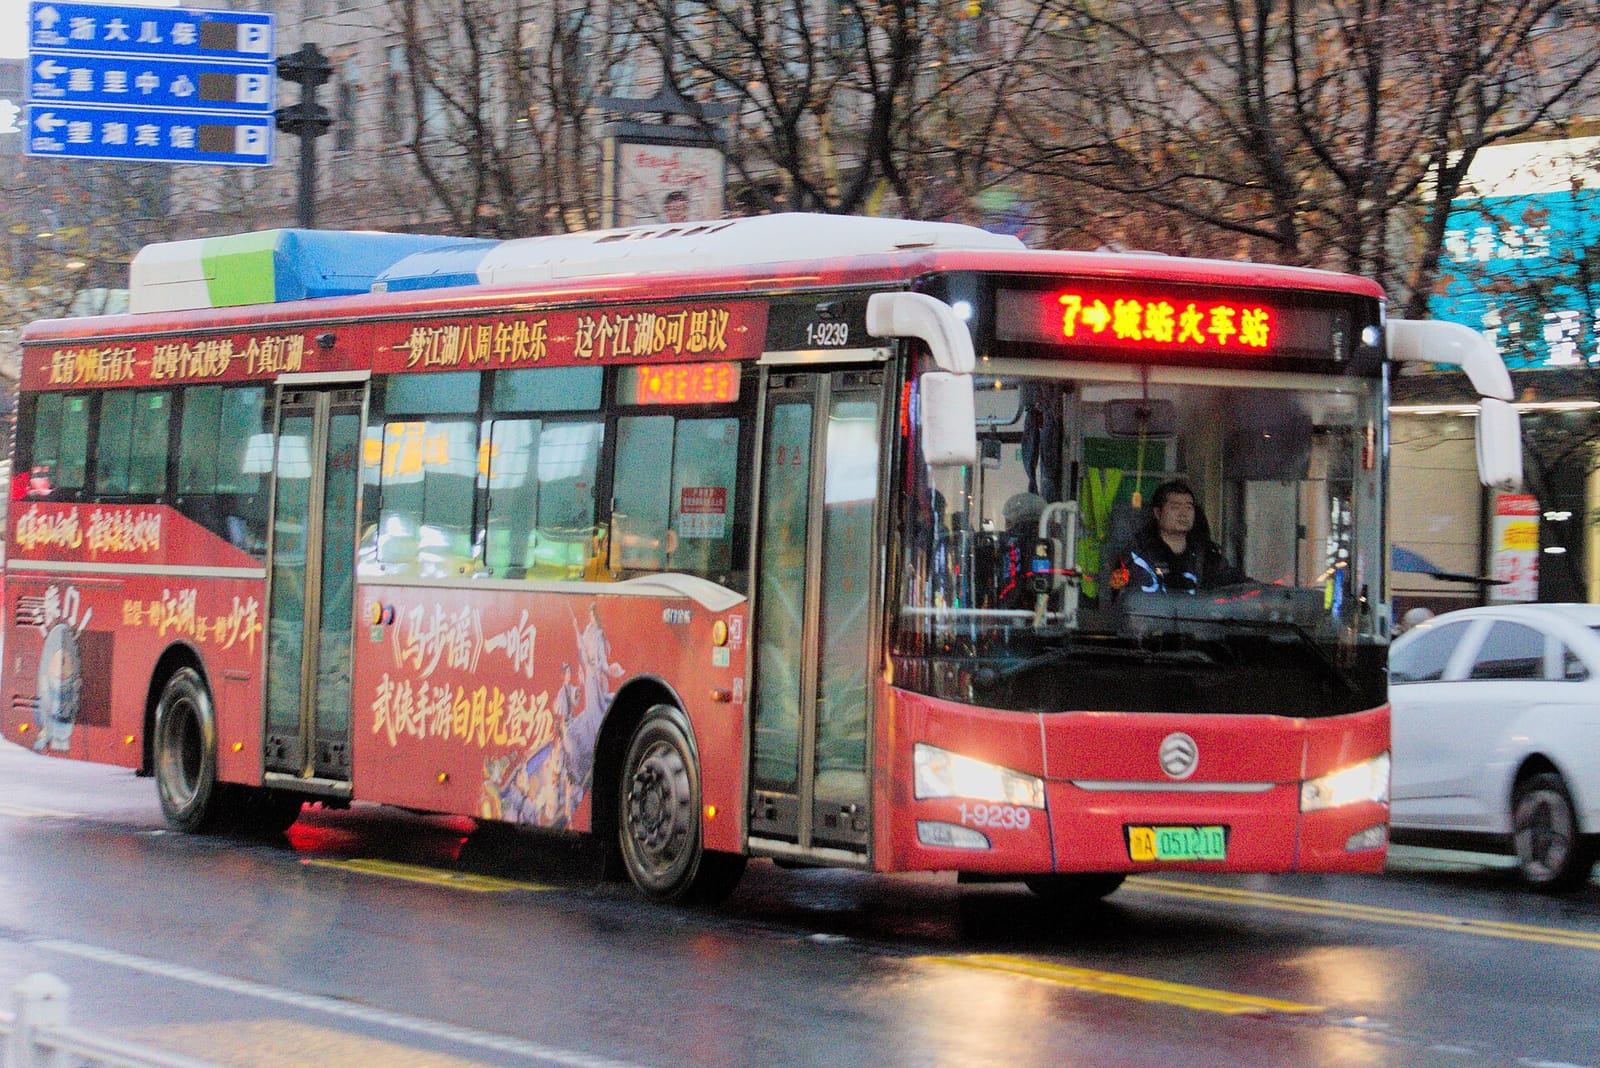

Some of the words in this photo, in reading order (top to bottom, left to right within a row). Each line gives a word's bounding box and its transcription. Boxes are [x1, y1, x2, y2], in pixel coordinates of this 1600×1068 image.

[574, 308, 732, 360] 这个江湖8可思议
[806, 323, 849, 346] 1-9239
[1059, 295, 1082, 337] 7
[392, 318, 548, 368] 一梦江湖八周年快乐
[371, 672, 555, 751] 武侠手游白月光登场
[958, 803, 1031, 829] 1-9239
